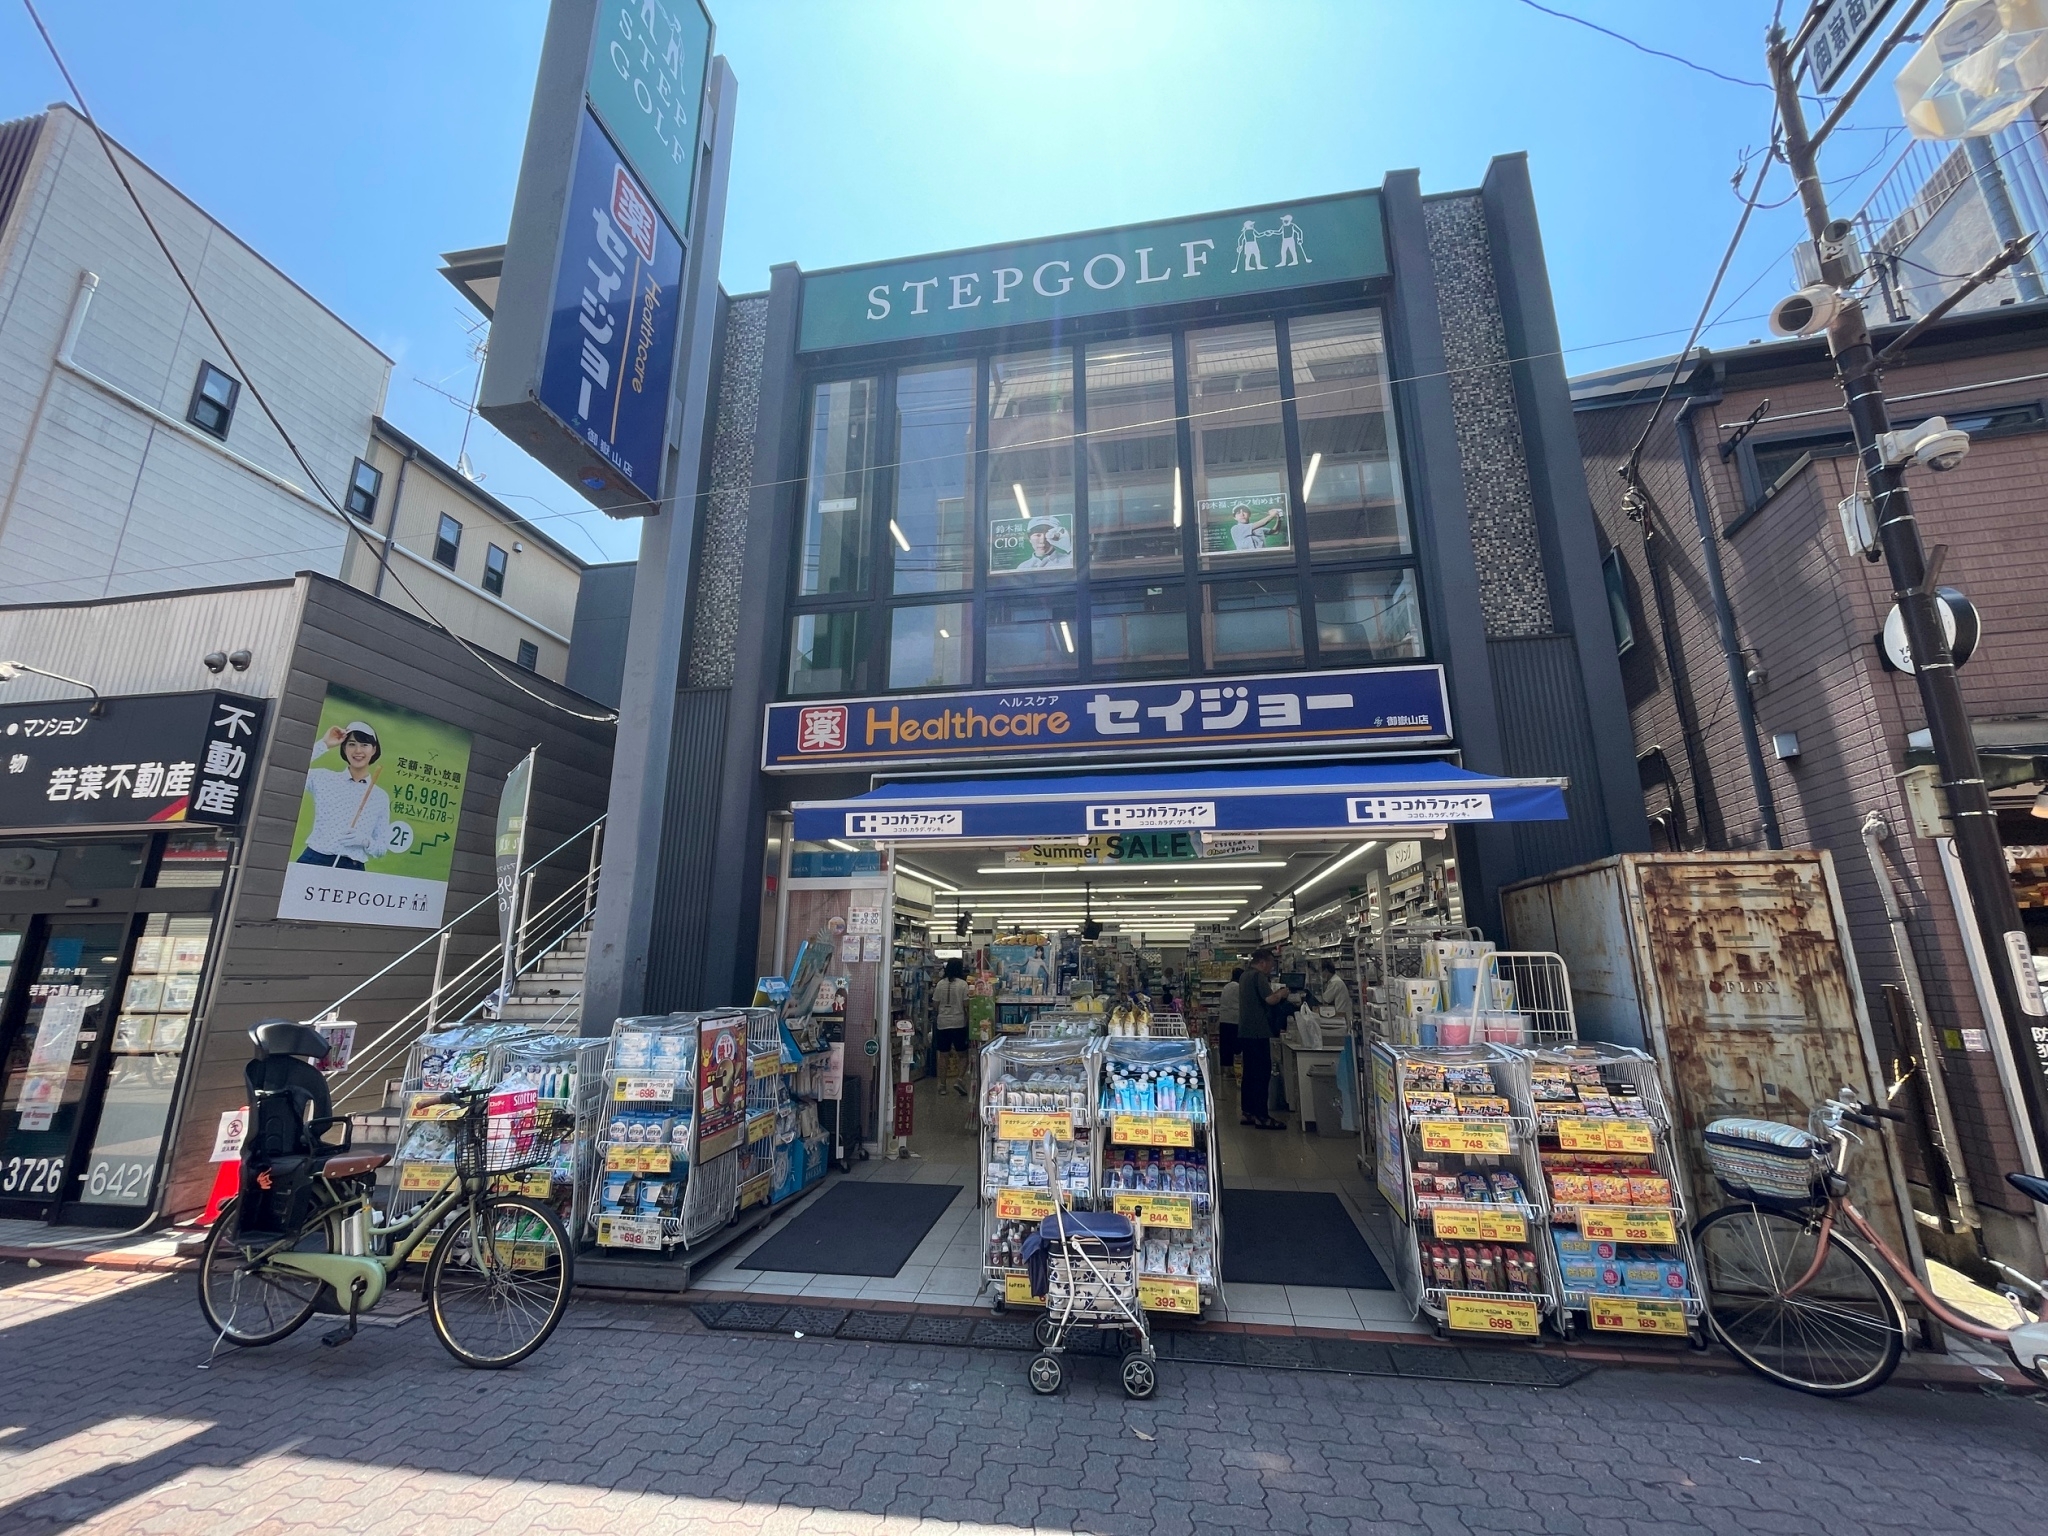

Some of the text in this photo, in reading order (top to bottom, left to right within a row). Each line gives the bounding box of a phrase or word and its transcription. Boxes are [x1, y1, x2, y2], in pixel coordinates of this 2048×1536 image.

[609, 39, 686, 166] GOLF
[866, 237, 1214, 321] STEPGOLF
[577, 206, 628, 422] セイジョー
[632, 272, 662, 395] Healthcare
[994, 537, 1018, 549] CIO
[998, 696, 1060, 709] ヘルスケア
[1087, 687, 1354, 735] セイジョー
[23, 716, 89, 738] マンション
[865, 705, 1071, 747] Healthcare
[194, 703, 256, 816] 不動産
[46, 761, 196, 801] 若葉不動産
[1125, 805, 1208, 819] ココカラファイン
[1391, 798, 1483, 811] ココカラファイン
[880, 813, 956, 826] ココカラファイン
[389, 826, 410, 847] 2F
[1032, 844, 1101, 859] Summer
[1106, 832, 1188, 860] SALE
[303, 885, 409, 911] STEPGOLF
[1461, 1139, 1484, 1149] 748
[1031, 1207, 1050, 1217] 289
[1149, 1213, 1169, 1222] 844
[1625, 1228, 1648, 1239] 928
[1488, 1317, 1513, 1330] 698
[1637, 1318, 1657, 1328] 189
